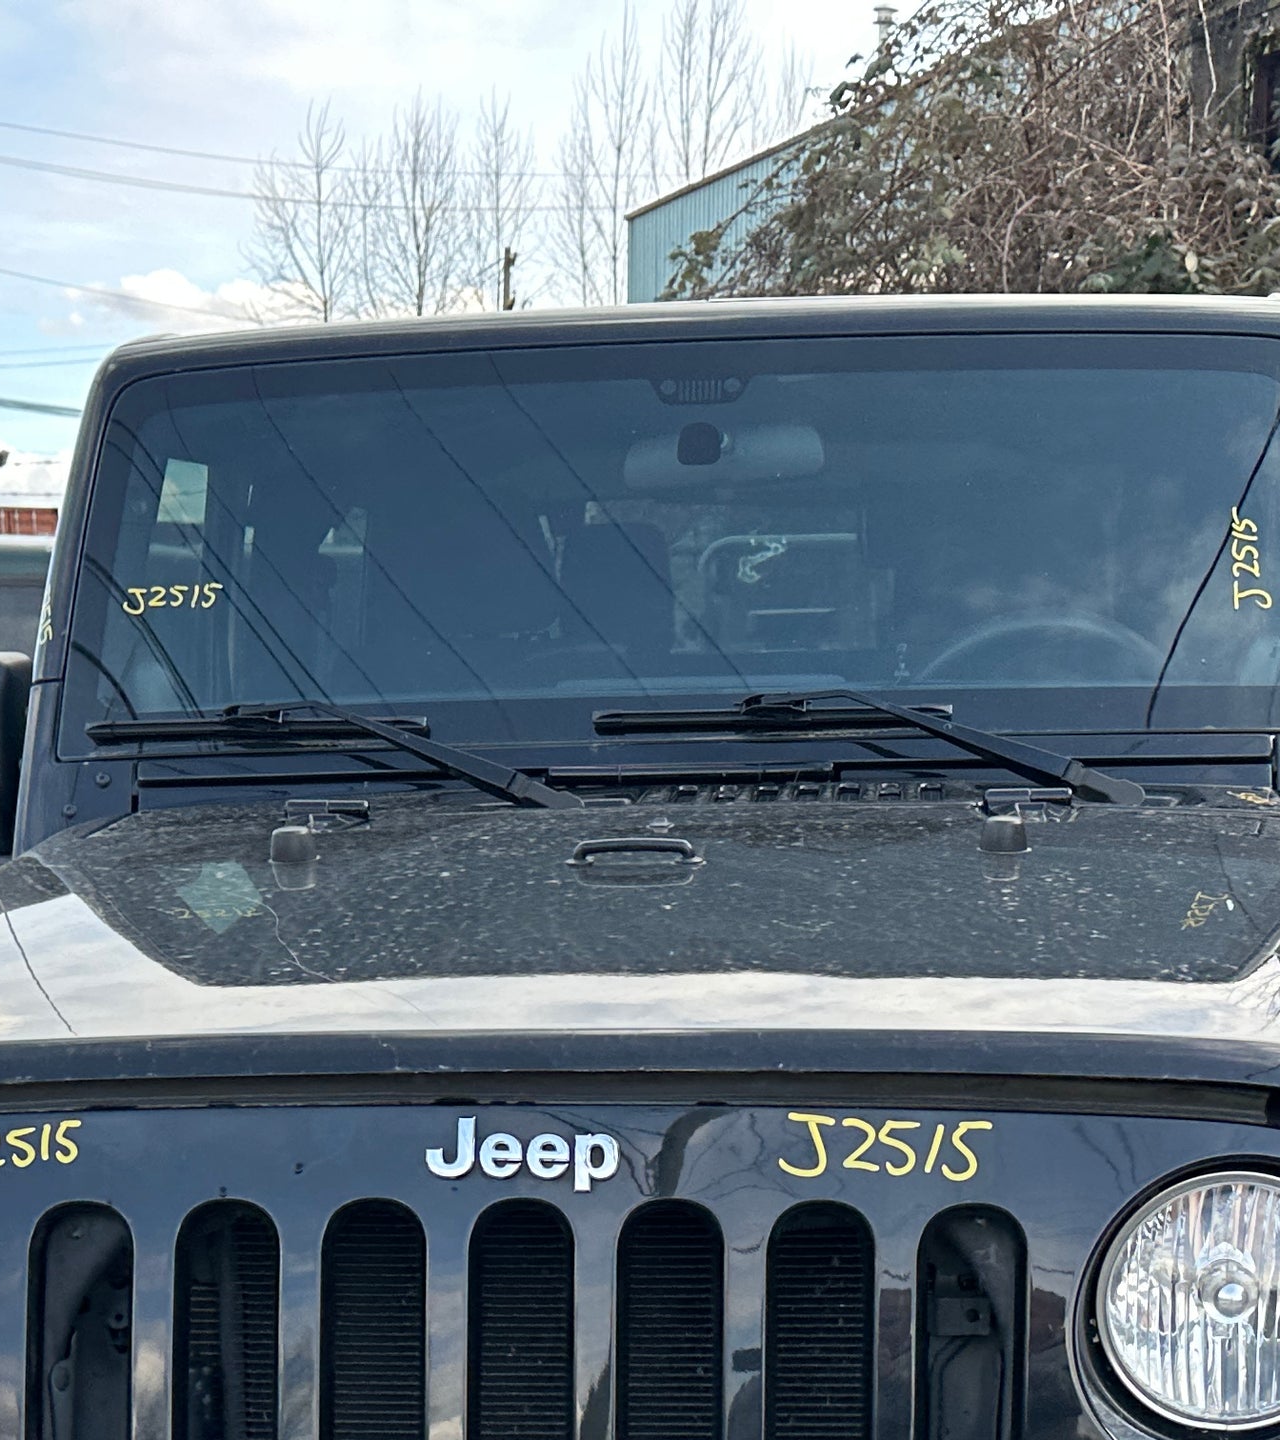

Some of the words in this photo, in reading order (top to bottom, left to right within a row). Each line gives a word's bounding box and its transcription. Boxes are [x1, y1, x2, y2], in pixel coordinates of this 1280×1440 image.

[1230, 506, 1273, 610] J2515
[122, 582, 224, 615] J2515
[425, 1115, 620, 1193] Jeep
[777, 1111, 993, 1182] J2515
